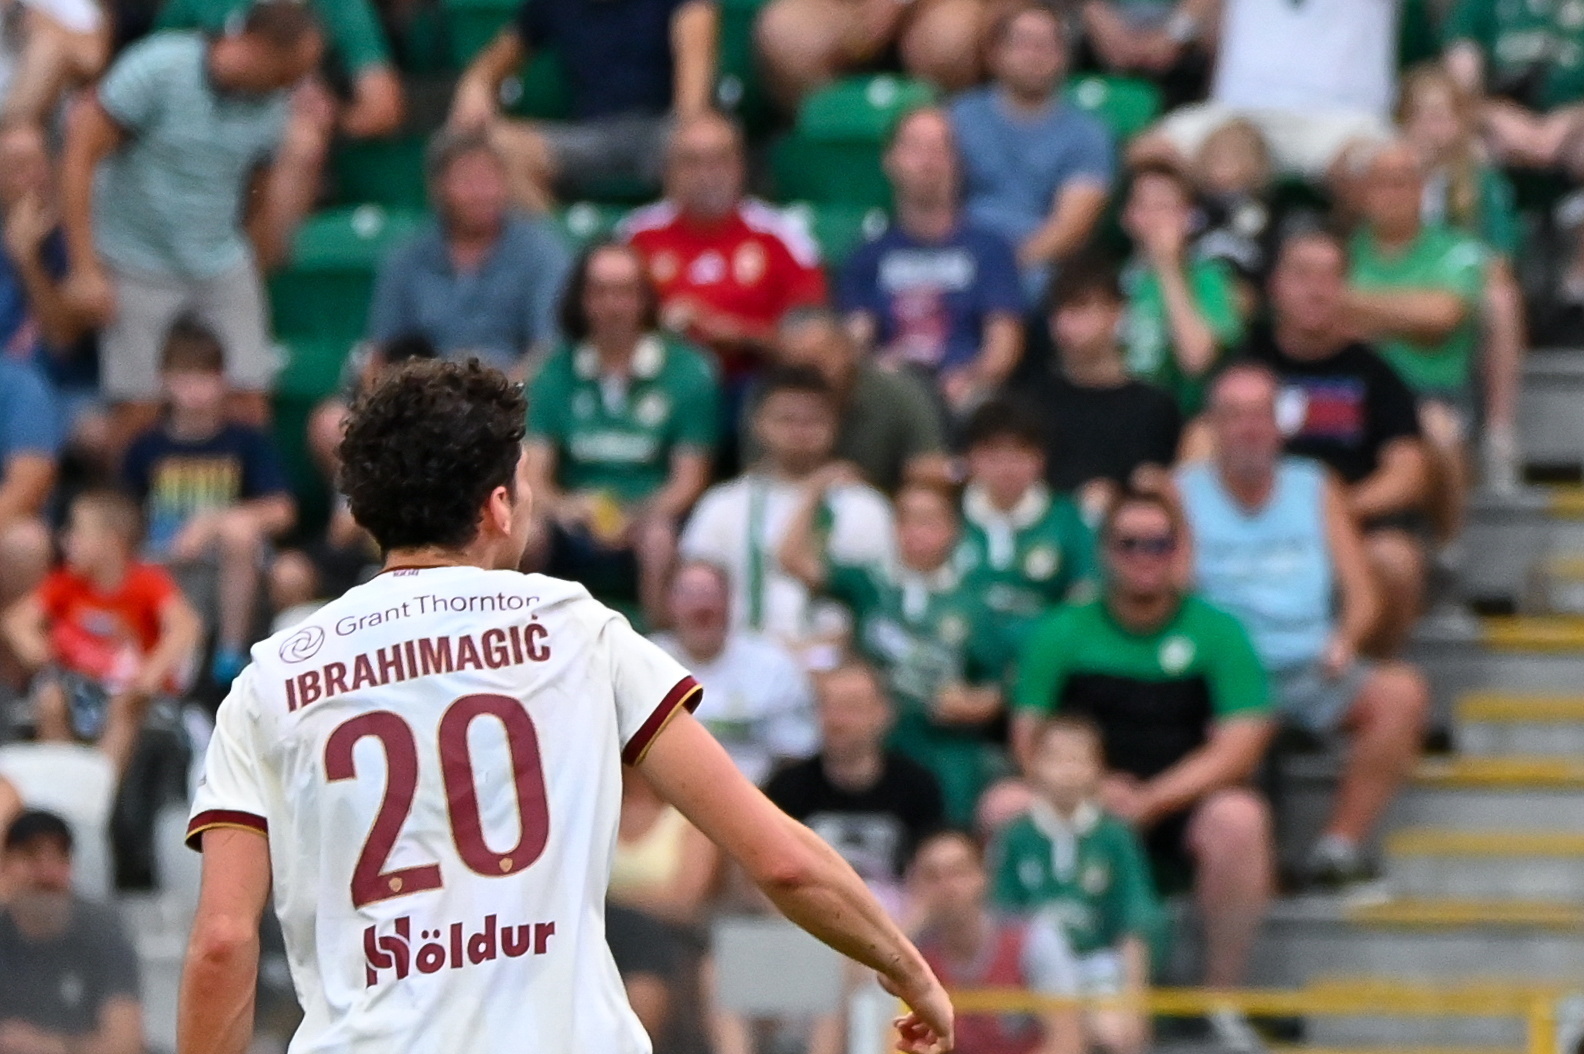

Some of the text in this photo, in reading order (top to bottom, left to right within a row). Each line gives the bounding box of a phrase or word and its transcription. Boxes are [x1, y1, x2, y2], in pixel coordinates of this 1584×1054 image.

[334, 589, 541, 637] Grant Thornton
[323, 692, 551, 910] 20
[363, 914, 556, 989] Höldur
